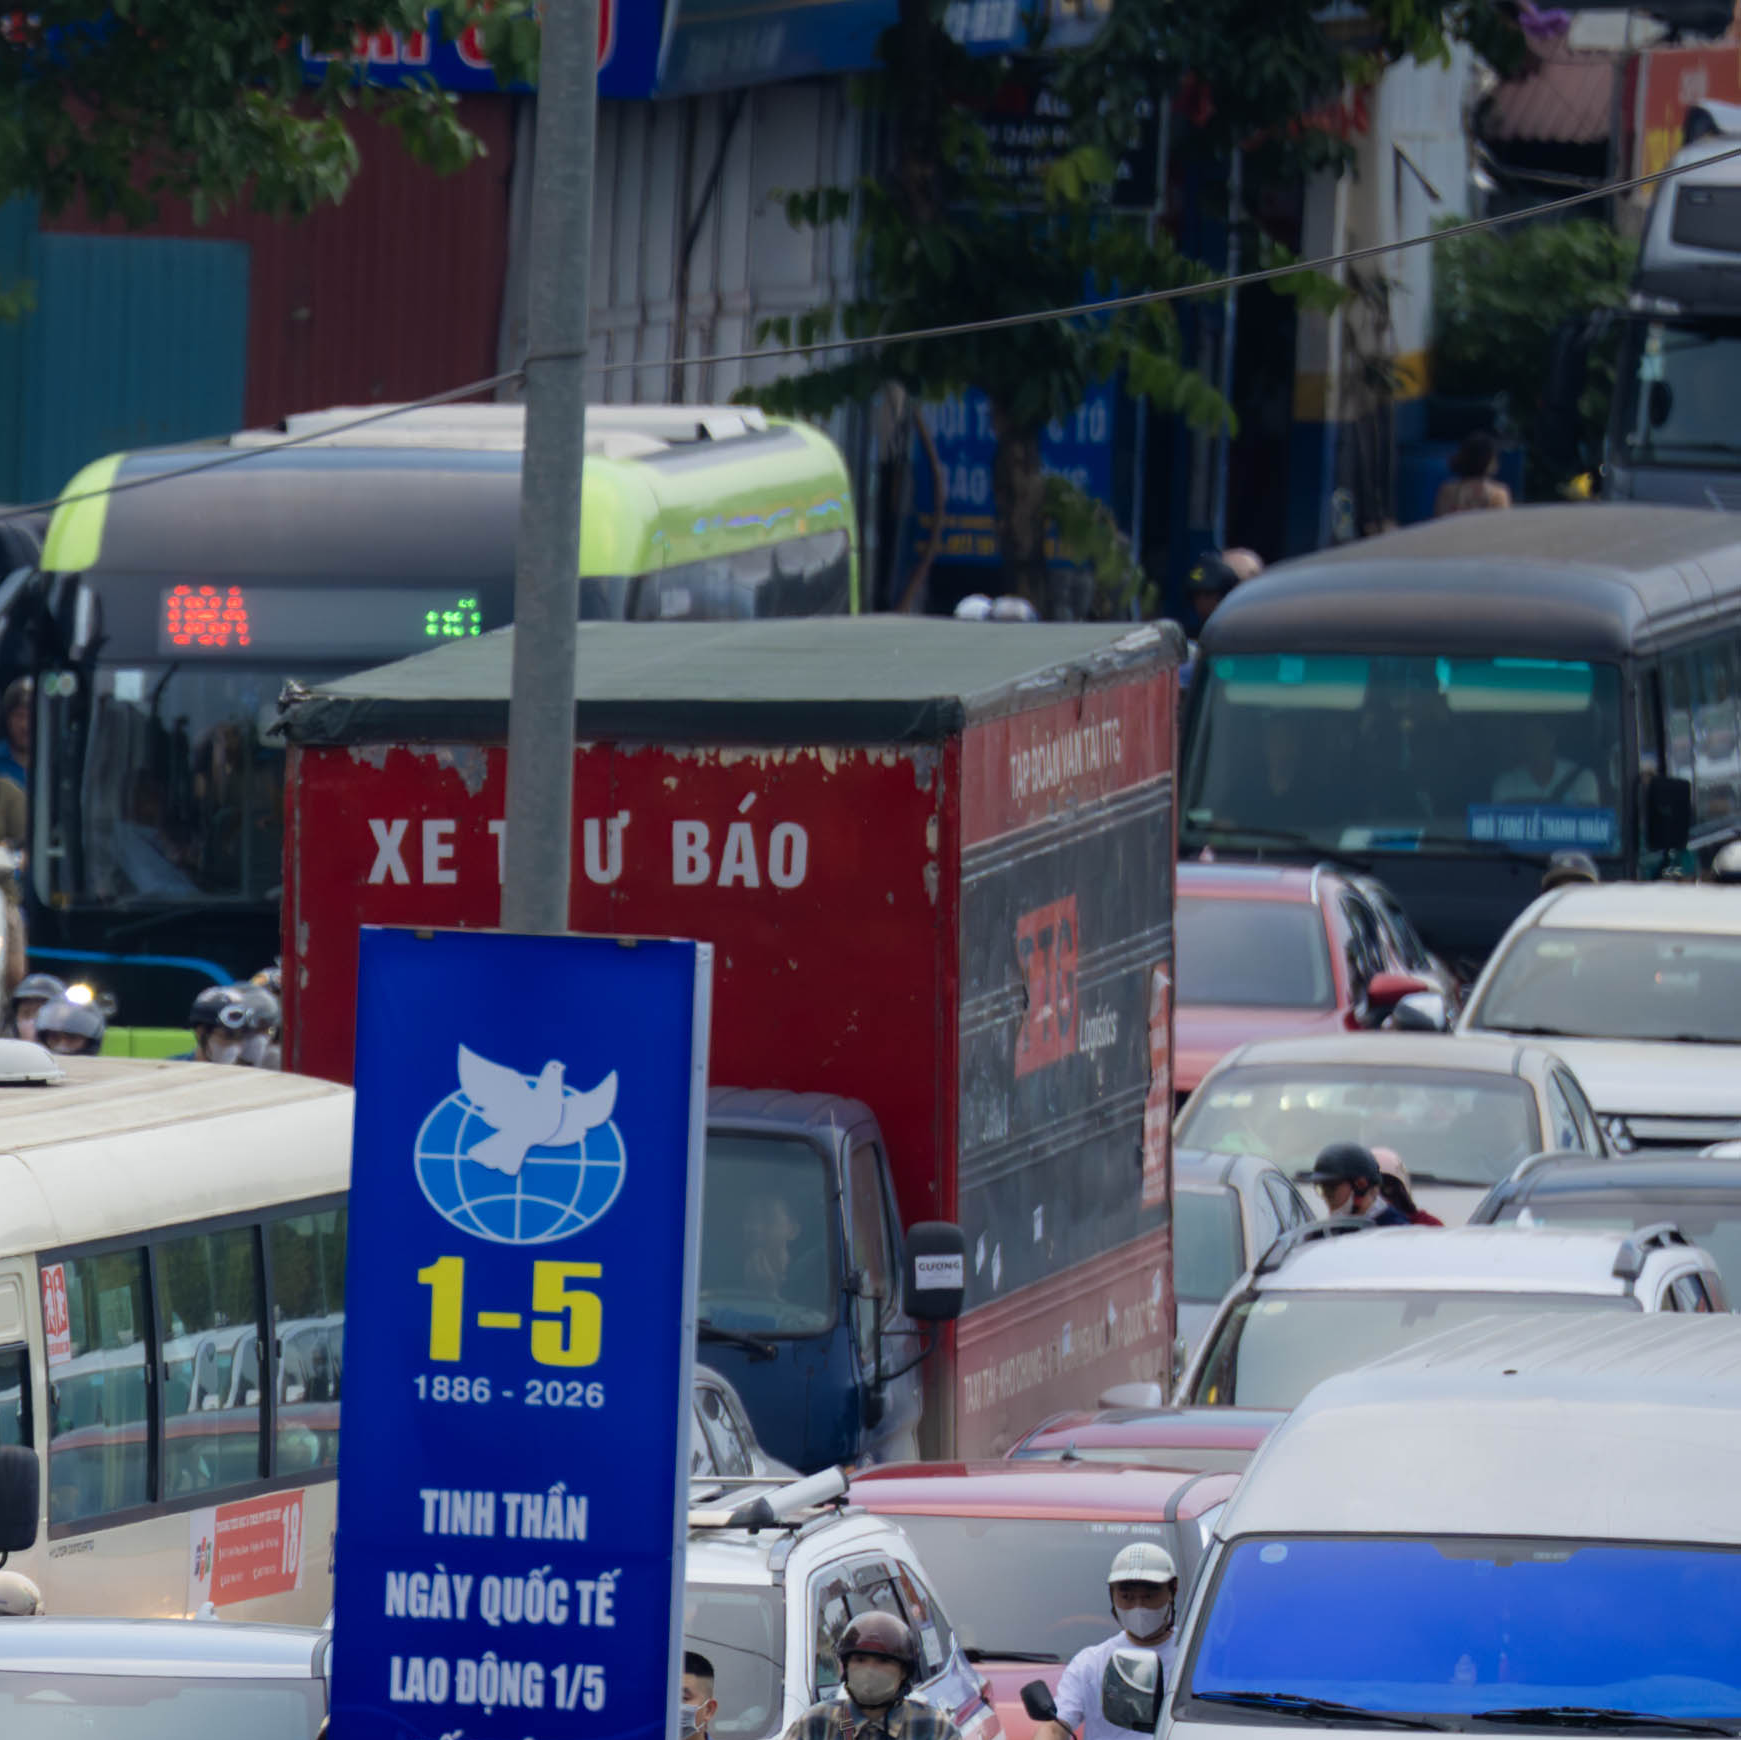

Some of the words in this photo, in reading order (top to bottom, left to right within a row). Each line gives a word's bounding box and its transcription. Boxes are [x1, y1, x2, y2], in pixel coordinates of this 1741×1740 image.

[367, 819, 457, 885] XE
[488, 809, 631, 886] TƯ
[672, 791, 809, 889] BÁO
[1079, 1004, 1118, 1060] Logistics
[417, 1255, 603, 1368] 1-5
[414, 1374, 491, 1405] 1886
[523, 1379, 605, 1410] 2026
[281, 1502, 301, 1576] 18
[419, 1488, 495, 1538] TINH
[501, 1481, 588, 1543] THẦN
[384, 1563, 474, 1621] NGÀY
[479, 1564, 570, 1627] QUỐC
[576, 1569, 623, 1627] TẾ
[389, 1655, 451, 1704] LAO
[455, 1651, 545, 1717] ĐỘNG
[551, 1663, 606, 1712] 1/5
